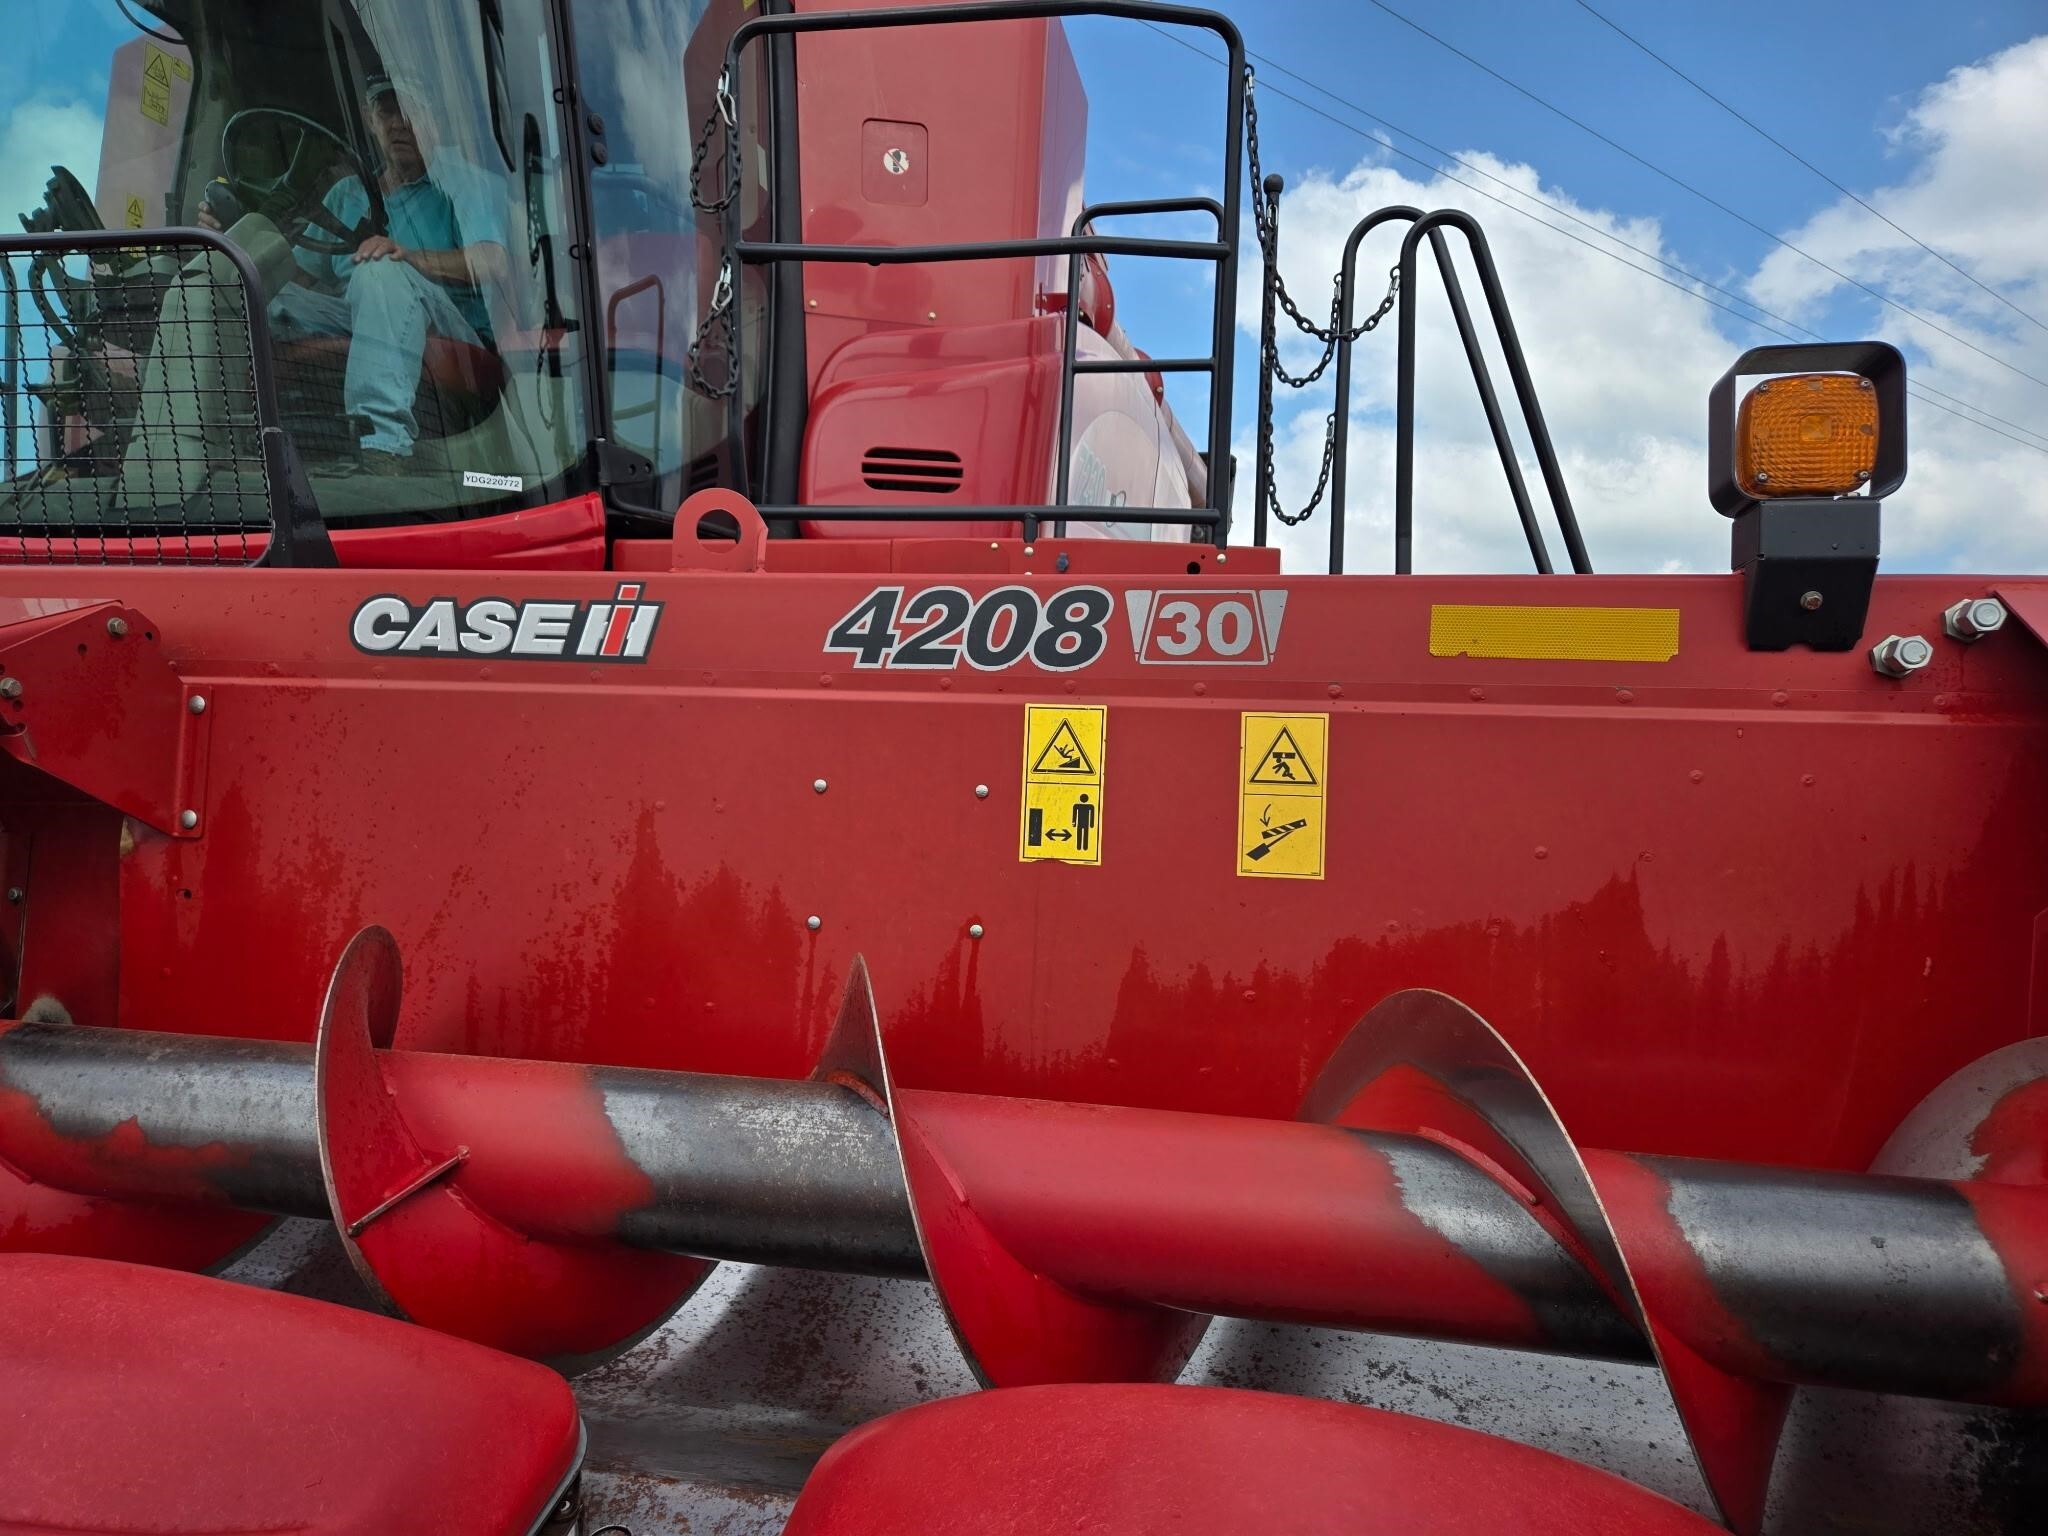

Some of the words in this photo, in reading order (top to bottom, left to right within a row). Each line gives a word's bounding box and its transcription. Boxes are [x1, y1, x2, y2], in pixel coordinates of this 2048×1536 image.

[465, 474, 520, 488] YDG220772
[353, 596, 577, 655] CASE
[822, 585, 1115, 672] 4208
[1156, 600, 1254, 656] 30
